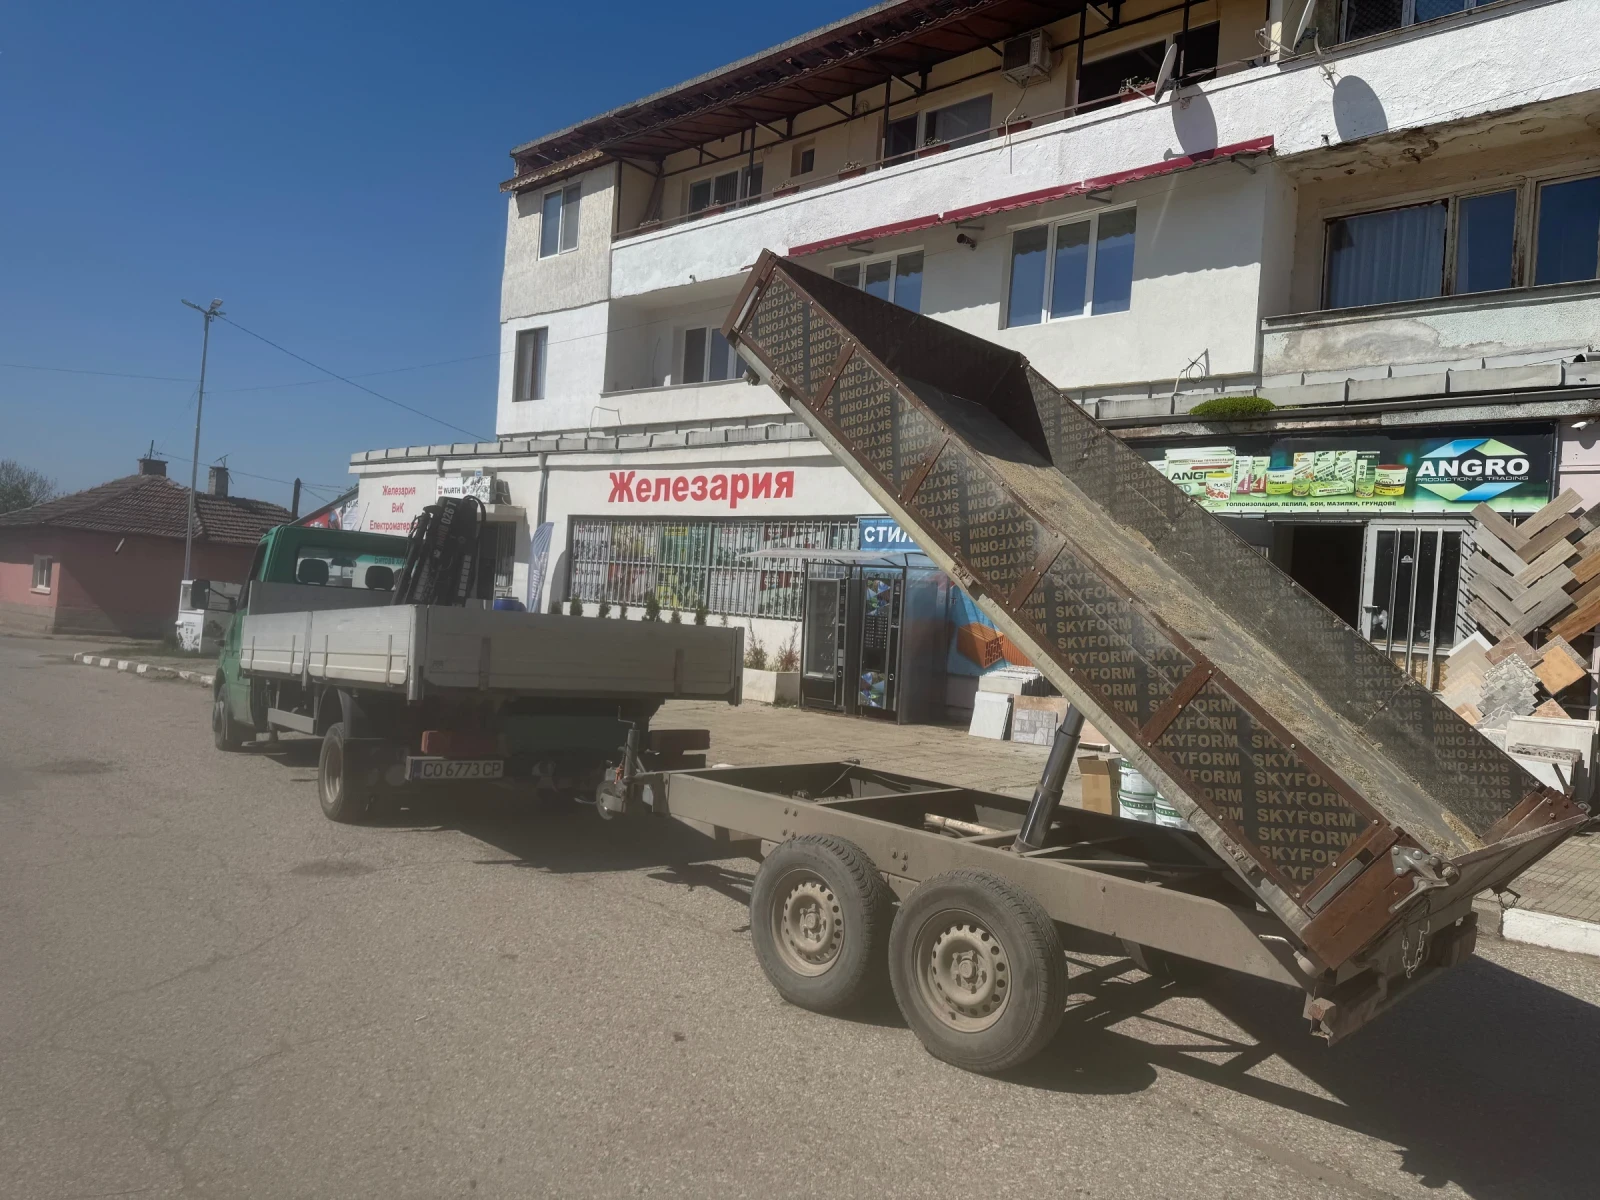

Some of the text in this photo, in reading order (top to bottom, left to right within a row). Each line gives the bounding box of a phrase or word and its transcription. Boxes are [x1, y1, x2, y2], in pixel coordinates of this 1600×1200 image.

[758, 300, 804, 324] SKYFORM
[758, 312, 804, 336] SKYFORM
[758, 324, 804, 348] SKYFORM
[765, 337, 805, 357] SKYFOR
[840, 392, 890, 415] SKYFORM
[840, 405, 891, 428] SKYFORM
[854, 433, 892, 450] SKYFO
[1416, 458, 1530, 477] ANGRO
[382, 485, 416, 500] Железария
[608, 471, 794, 509] Железария
[912, 488, 959, 506] SKYFOR
[391, 502, 404, 513] ВиК
[920, 502, 960, 518] SKYFO
[968, 507, 1024, 525] KYFORM
[969, 520, 1034, 540] SKYFORM
[970, 535, 1035, 554] SKYFORM
[971, 551, 1036, 568] SKYFORM
[1056, 601, 1131, 618] SKYFORM
[1057, 617, 1132, 634] SKYFORM
[1058, 633, 1133, 650] SKYFORM
[1067, 650, 1134, 665] KYFORM
[1165, 751, 1240, 766] KYFORM
[445, 762, 481, 777] 6773
[482, 762, 502, 776] CP
[1254, 771, 1328, 787] SKYFO
[1257, 808, 1356, 828] SKYFORM
[1258, 826, 1357, 847] SKYFORM
